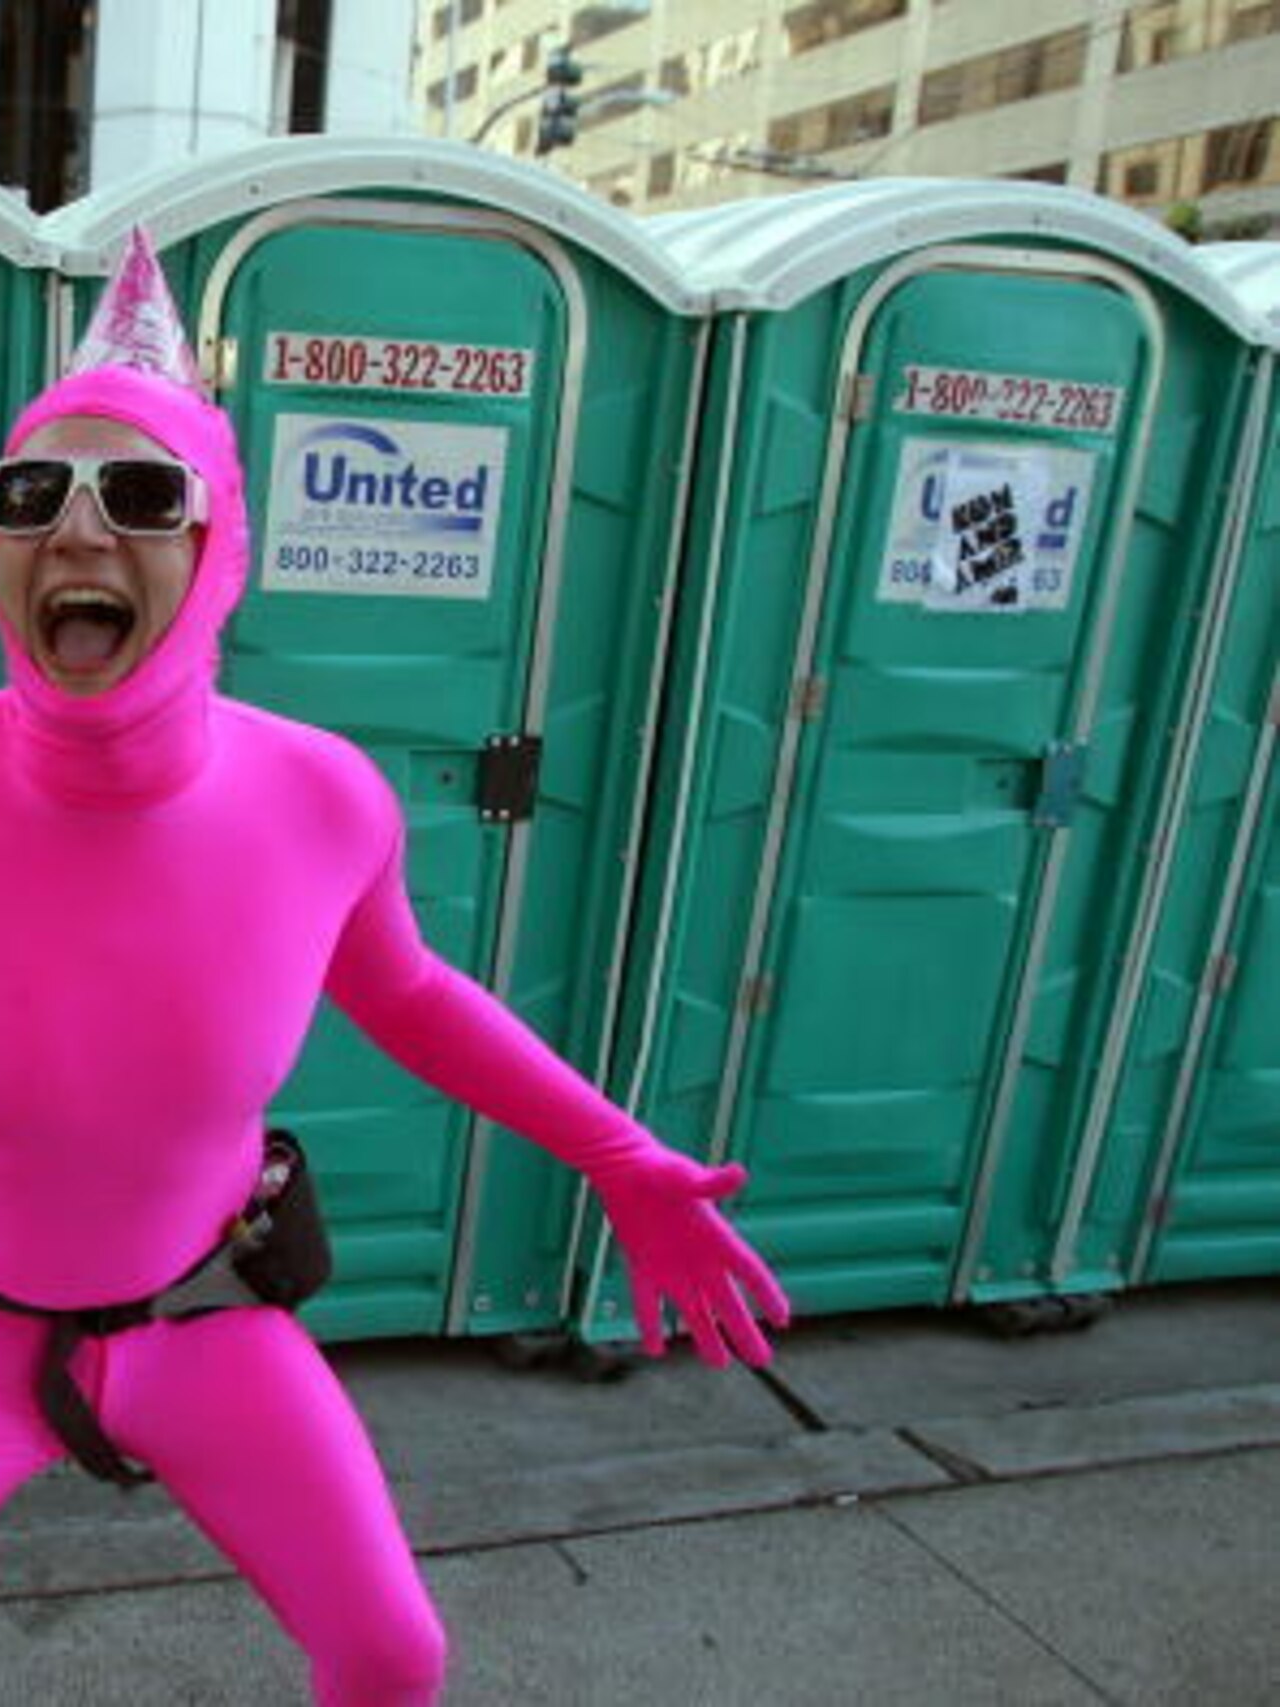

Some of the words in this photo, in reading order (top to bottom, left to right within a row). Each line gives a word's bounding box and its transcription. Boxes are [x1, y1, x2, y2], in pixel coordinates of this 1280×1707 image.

[273, 336, 526, 393] 1-800-322-2263
[304, 452, 488, 511] United
[278, 546, 480, 579] 800-322-2263
